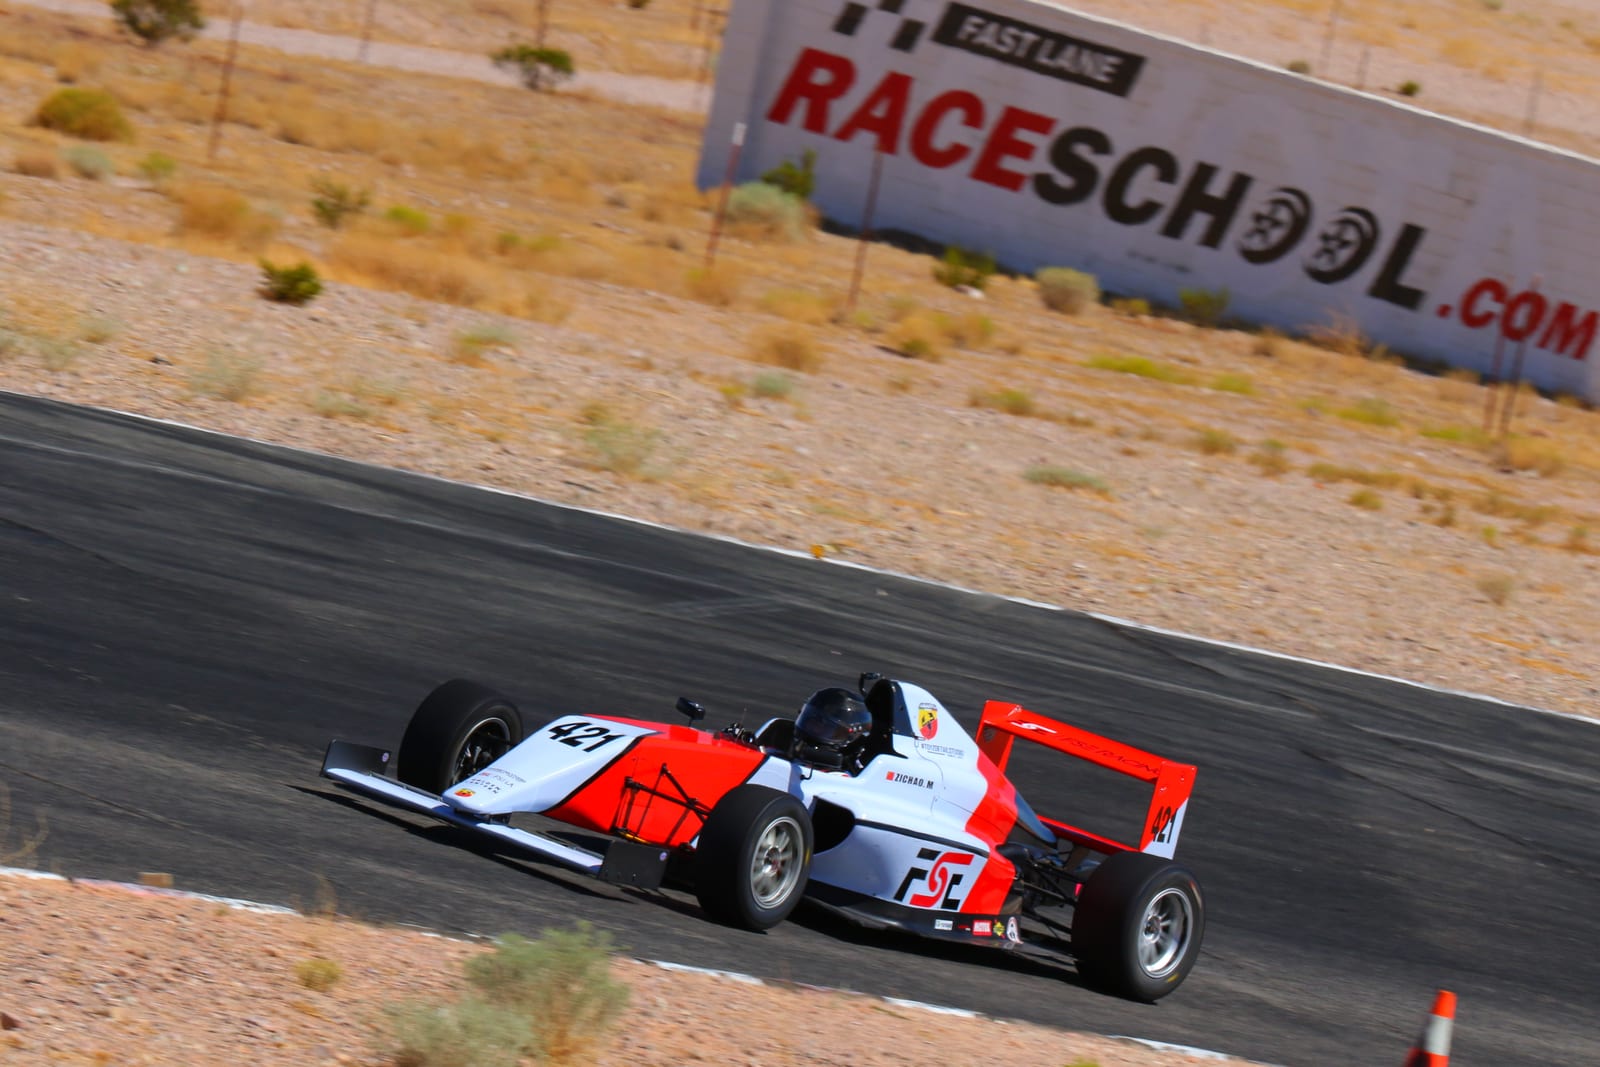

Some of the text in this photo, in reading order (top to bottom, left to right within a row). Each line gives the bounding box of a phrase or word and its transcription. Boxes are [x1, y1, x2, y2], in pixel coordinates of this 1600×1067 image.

[956, 15, 1125, 84] FAST LANE
[547, 721, 626, 753] 421
[1151, 805, 1179, 844] 421
